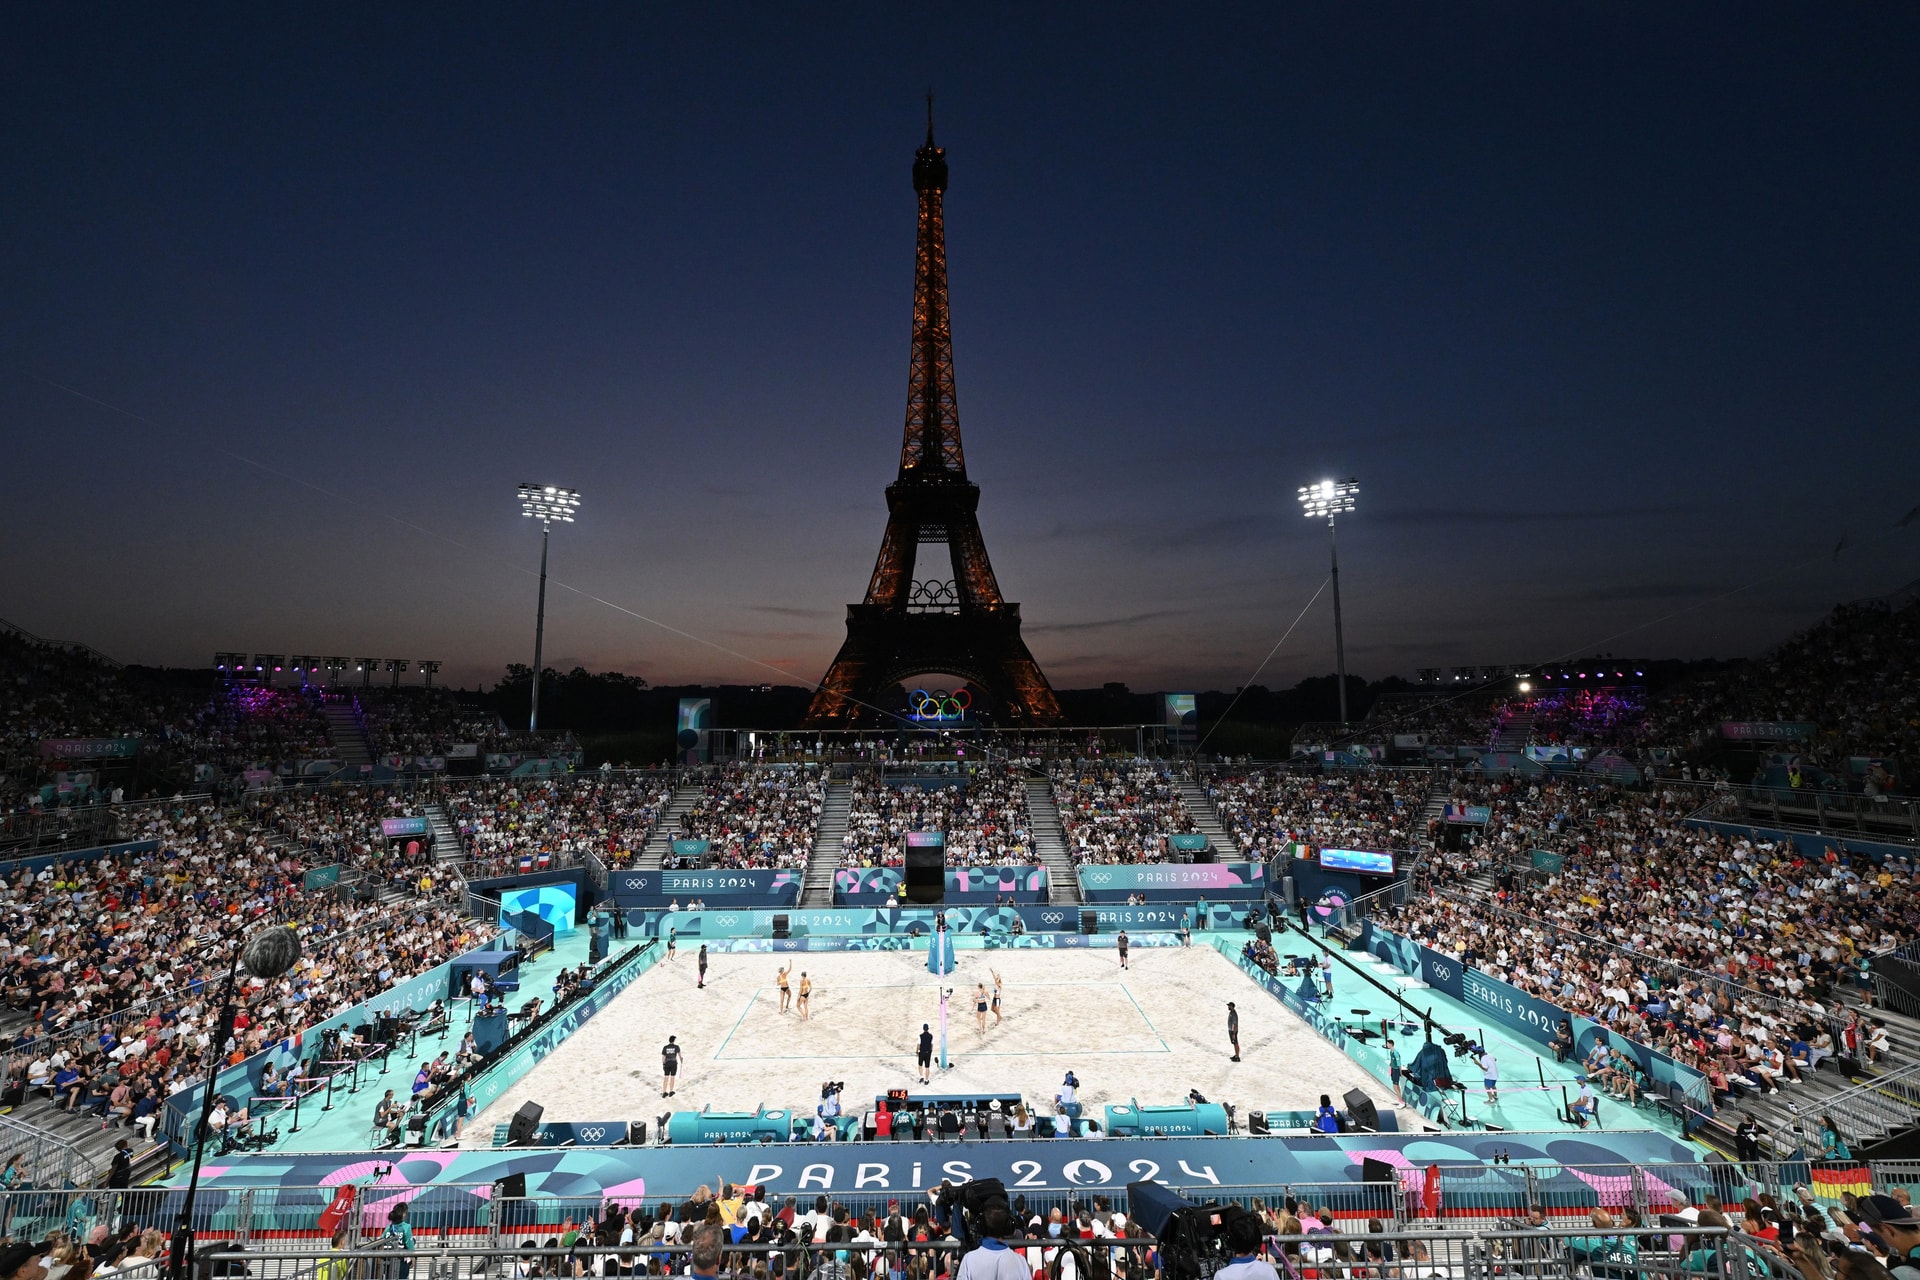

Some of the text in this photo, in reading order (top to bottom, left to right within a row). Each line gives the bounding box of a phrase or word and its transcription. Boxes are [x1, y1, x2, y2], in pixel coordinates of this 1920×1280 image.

[96, 743, 126, 753] 2024
[1182, 872, 1218, 882] 2024
[719, 878, 756, 888] 2024
[813, 915, 851, 926] 2024
[1137, 911, 1175, 922] 2024
[417, 978, 448, 1002] 2024
[1010, 1159, 1221, 1187] 2024
